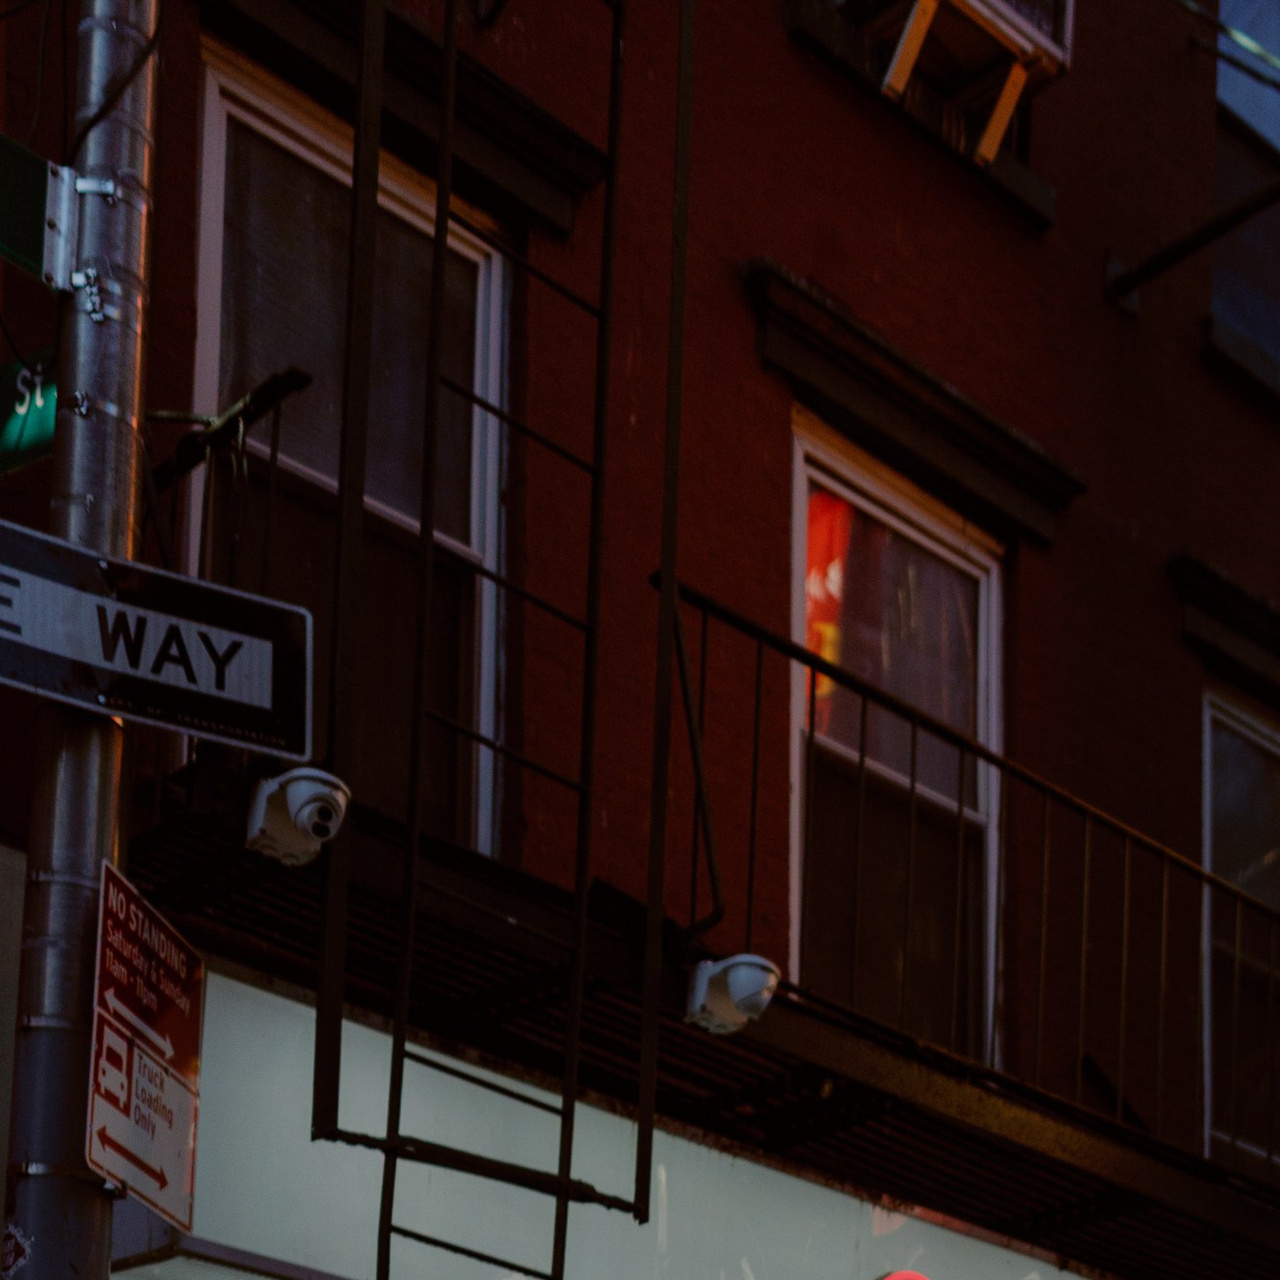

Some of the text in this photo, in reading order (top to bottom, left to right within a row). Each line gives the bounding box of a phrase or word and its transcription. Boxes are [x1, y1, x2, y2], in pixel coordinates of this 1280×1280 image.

[15, 361, 45, 415] St
[97, 604, 243, 691] WAY
[108, 880, 188, 980] NO STANDING
[106, 918, 149, 977] Saturday
[159, 966, 191, 1018] Sunday
[138, 1051, 165, 1093] Truck
[134, 1104, 156, 1142] Only
[135, 1077, 173, 1130] Loading
